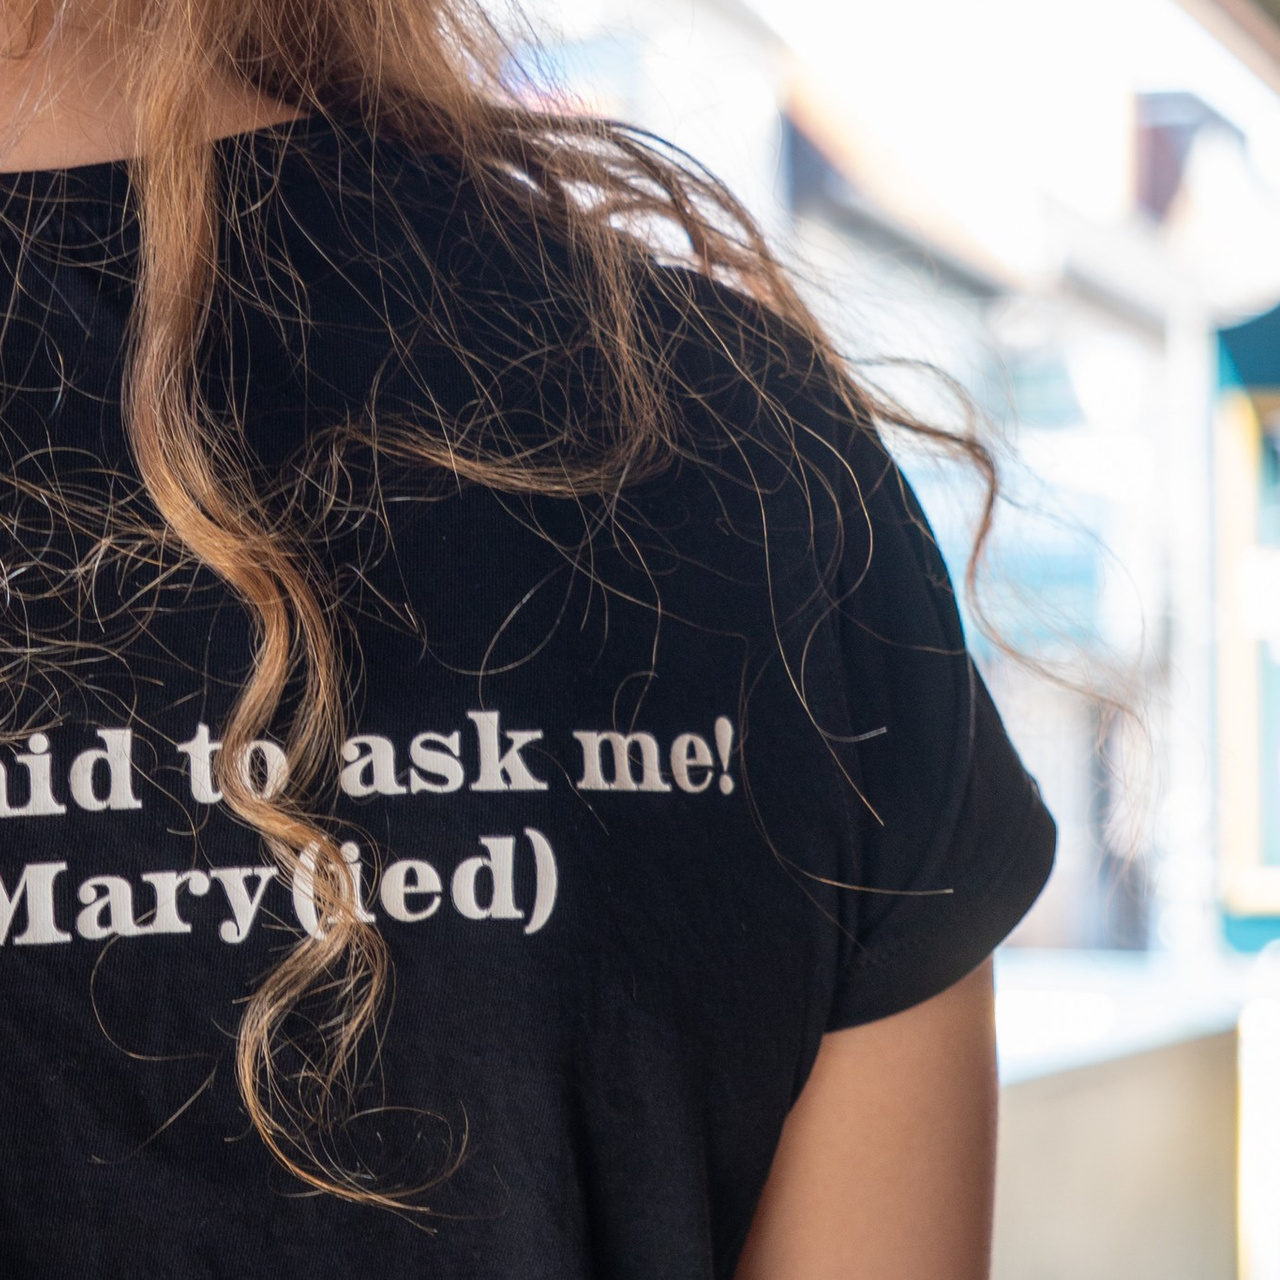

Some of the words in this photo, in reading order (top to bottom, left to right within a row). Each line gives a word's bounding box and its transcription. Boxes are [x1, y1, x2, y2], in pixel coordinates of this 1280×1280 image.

[176, 722, 290, 805] to
[339, 711, 548, 798] ask
[573, 716, 734, 796] me!
